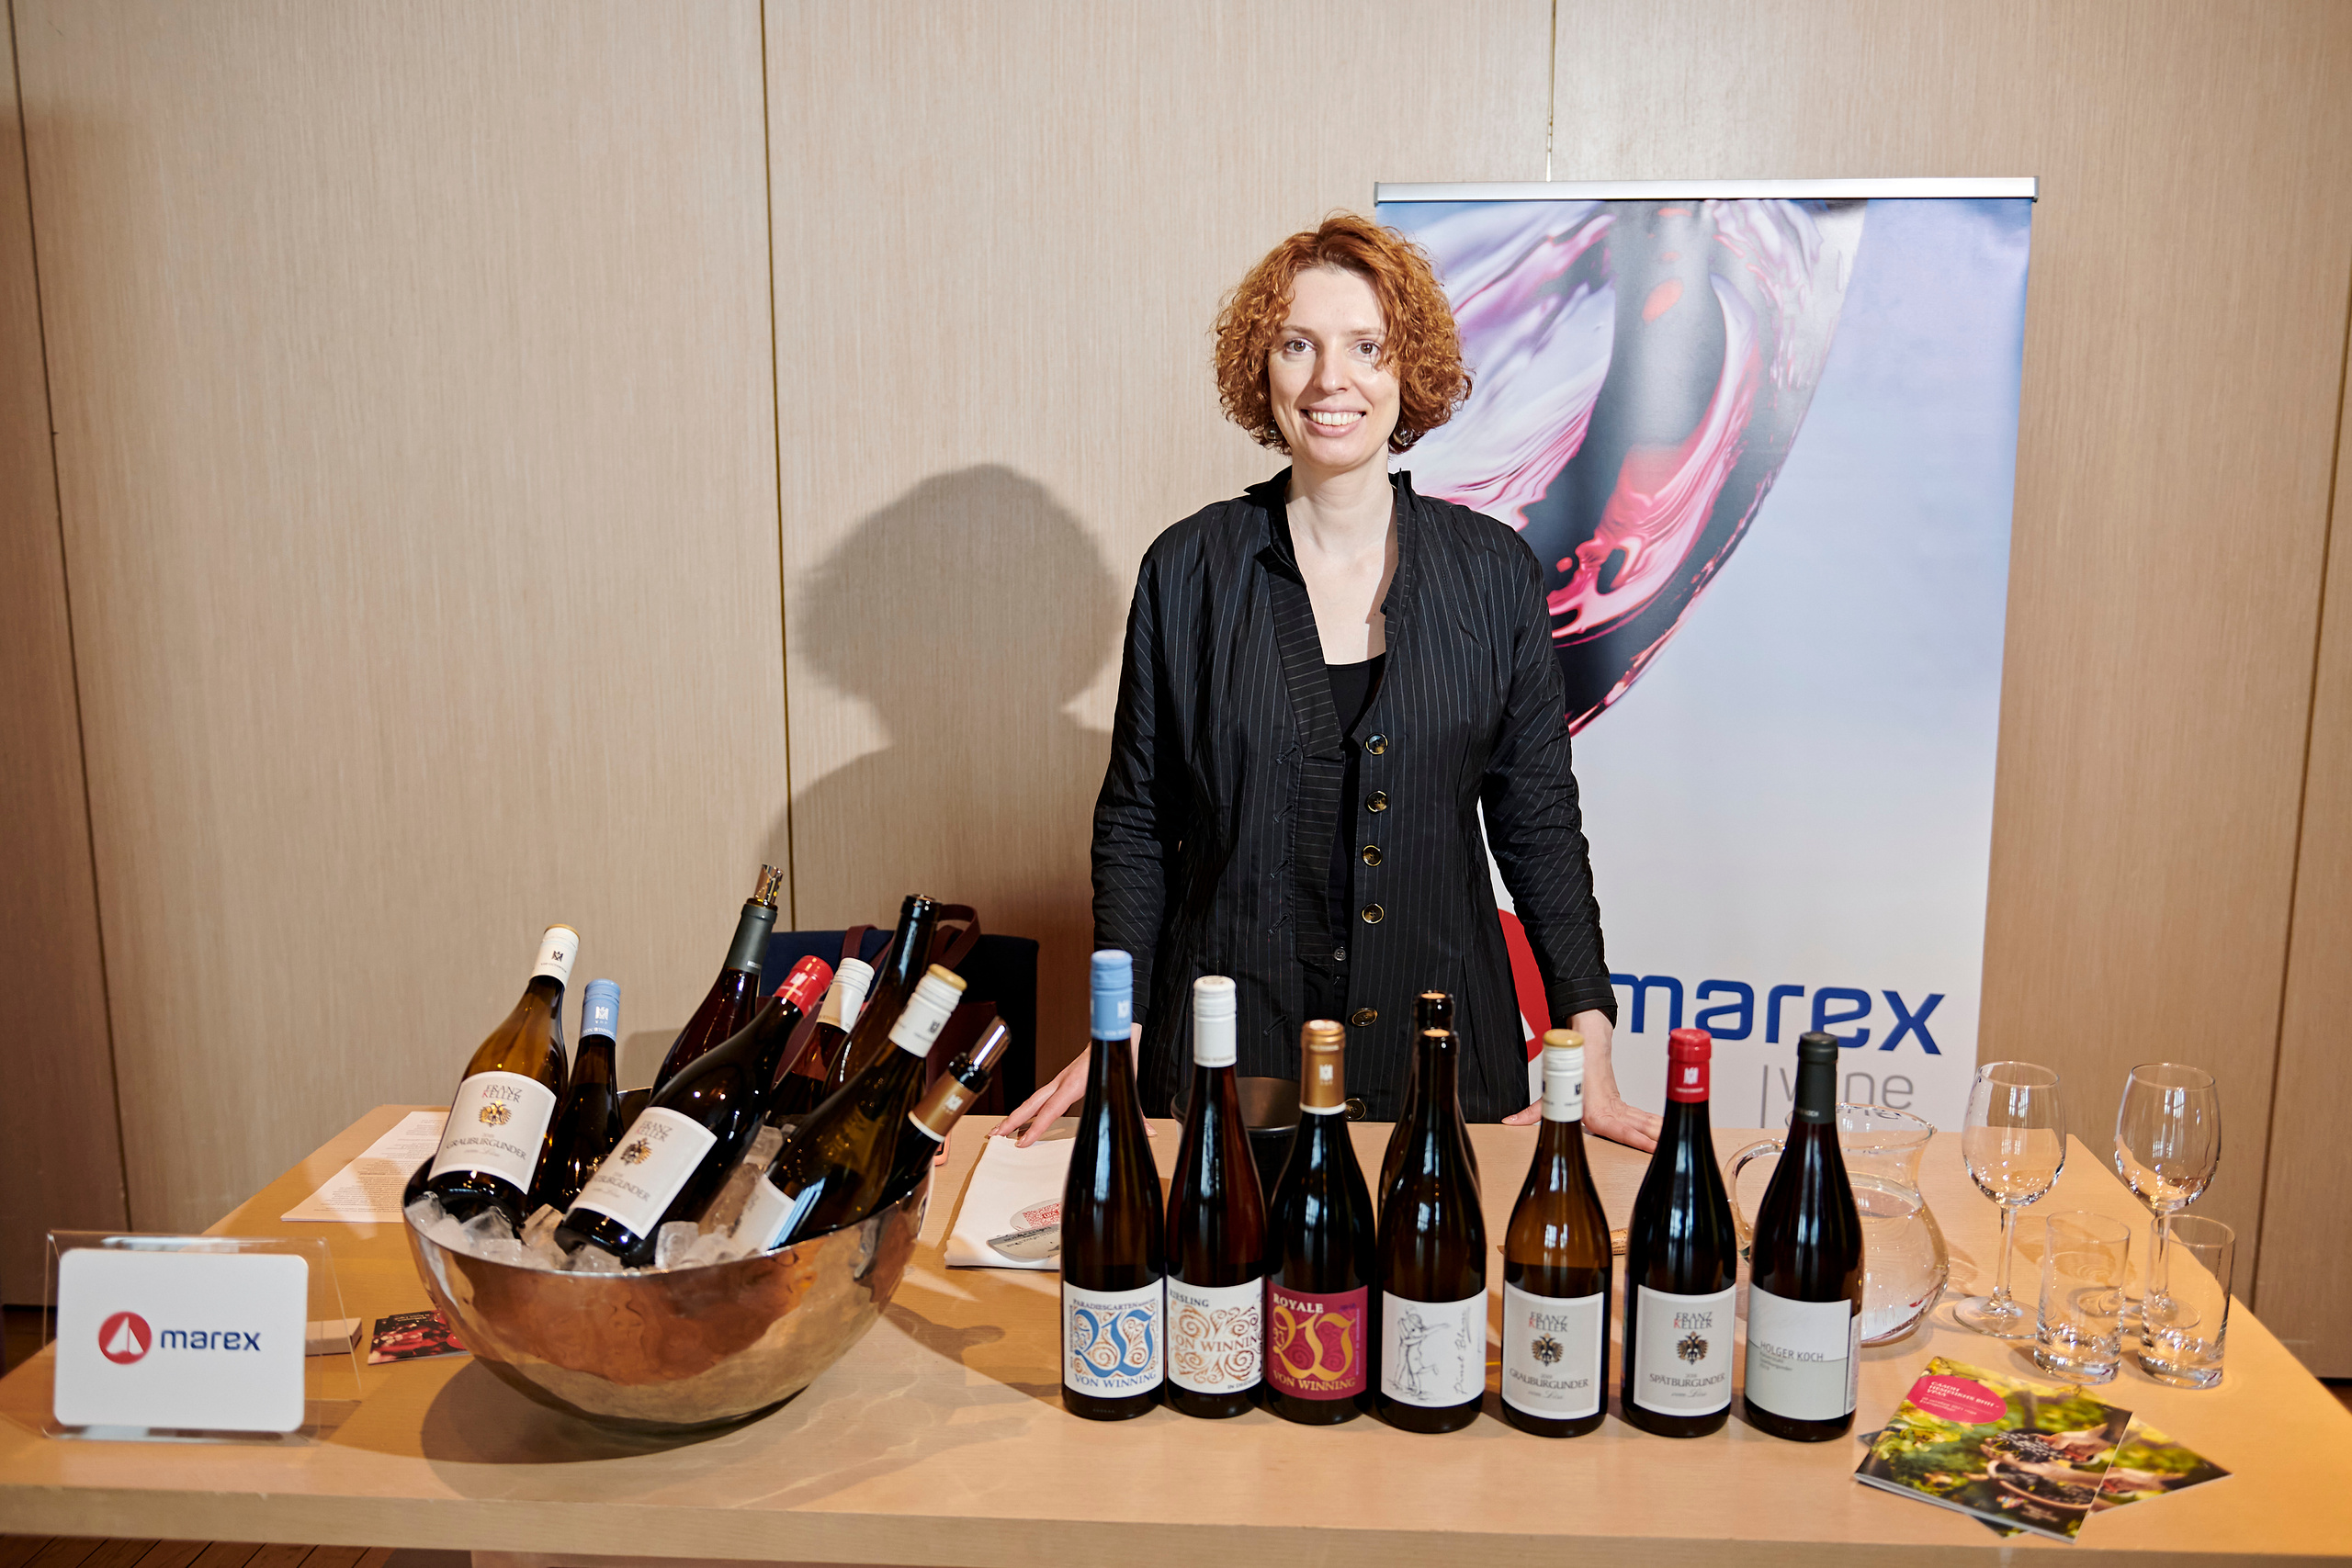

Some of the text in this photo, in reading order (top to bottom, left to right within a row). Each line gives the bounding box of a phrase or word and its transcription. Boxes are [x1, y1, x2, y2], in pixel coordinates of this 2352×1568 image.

[1610, 973, 1946, 1055] marex
[481, 1089, 522, 1103] KELLER
[486, 1084, 523, 1096] FRANZ
[1170, 1288, 1210, 1308] RIESLING
[1273, 1292, 1325, 1314] ROYALE
[1528, 1318, 1568, 1333] KELLER
[1530, 1311, 1568, 1325] FRANZ
[1673, 1318, 1713, 1330] KELLER
[1675, 1311, 1713, 1322] FRANZ
[161, 1329, 261, 1352] marex
[1759, 1340, 1794, 1359] HOLGER
[1796, 1351, 1825, 1362] KOCH
[1074, 1370, 1157, 1388] VON WINNING
[1273, 1370, 1295, 1387] VON
[1297, 1377, 1356, 1392] WINNING
[1509, 1367, 1589, 1390] GRAUBURGUNDER
[1648, 1372, 1726, 1388] SPÄTBURGUNDER
